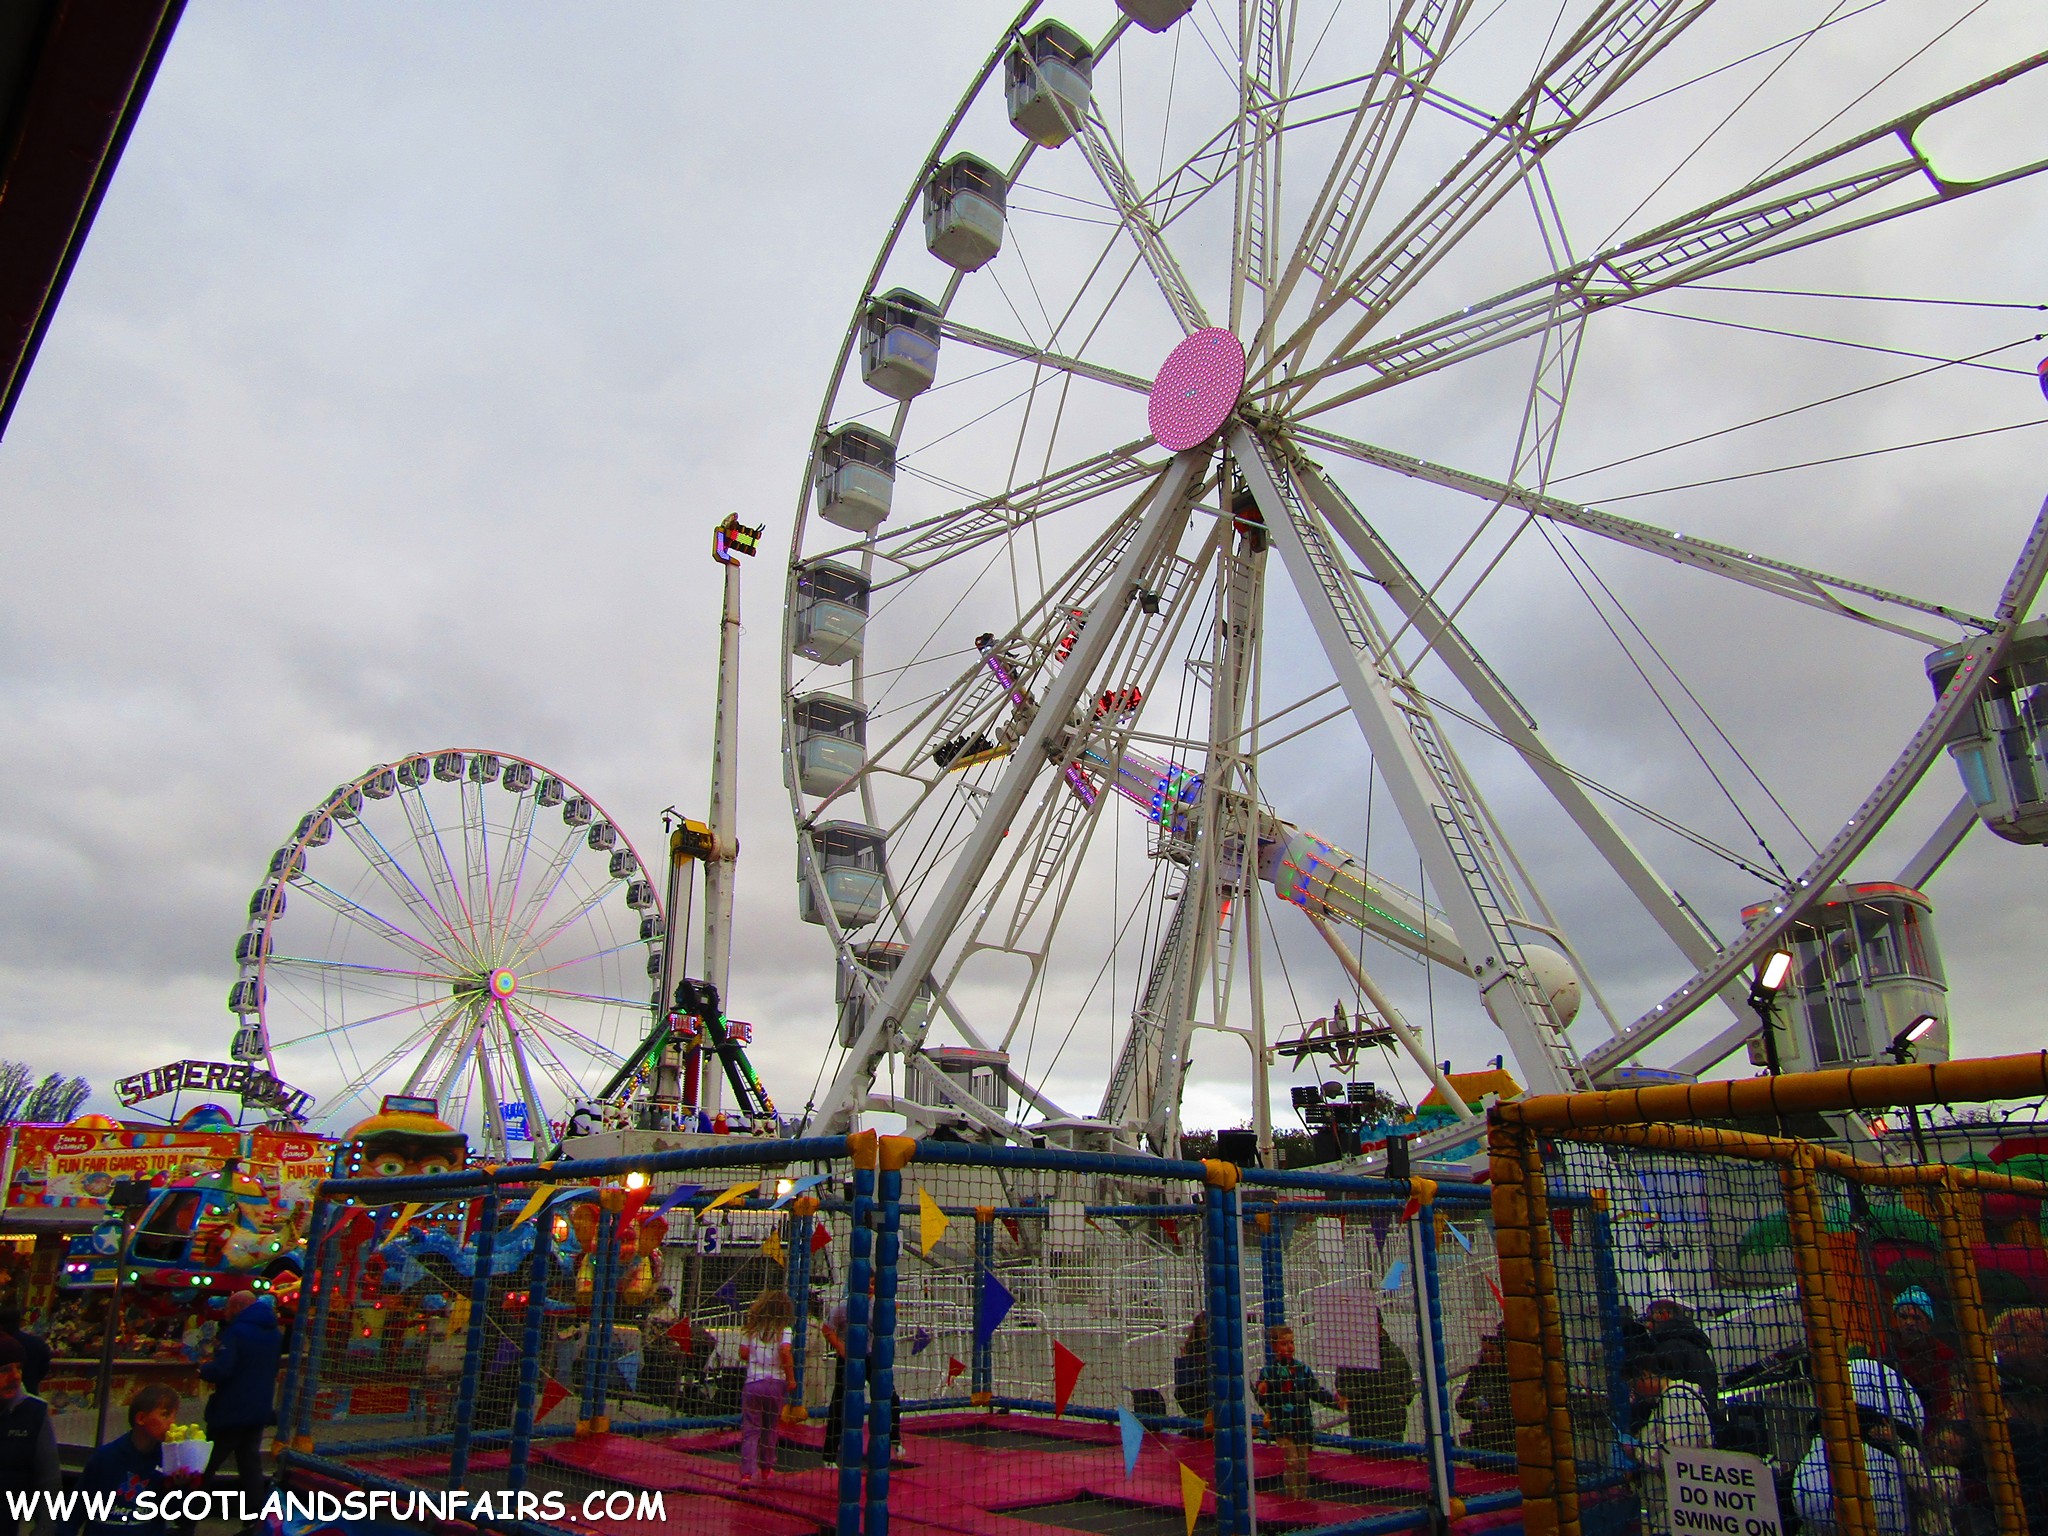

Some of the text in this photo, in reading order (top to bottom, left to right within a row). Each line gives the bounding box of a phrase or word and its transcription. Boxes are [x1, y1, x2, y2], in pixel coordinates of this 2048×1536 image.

[53, 1142, 88, 1151] Games
[57, 1158, 80, 1174] FUN
[82, 1157, 107, 1173] FAIR
[109, 1155, 148, 1171] GAMES
[151, 1155, 166, 1169] TO
[287, 1164, 306, 1179] FUN
[307, 1164, 325, 1178] FAIR
[1676, 1462, 1755, 1487] PLEASE
[1680, 1486, 1756, 1511] DO NOT
[1673, 1509, 1777, 1536] SWING ON
